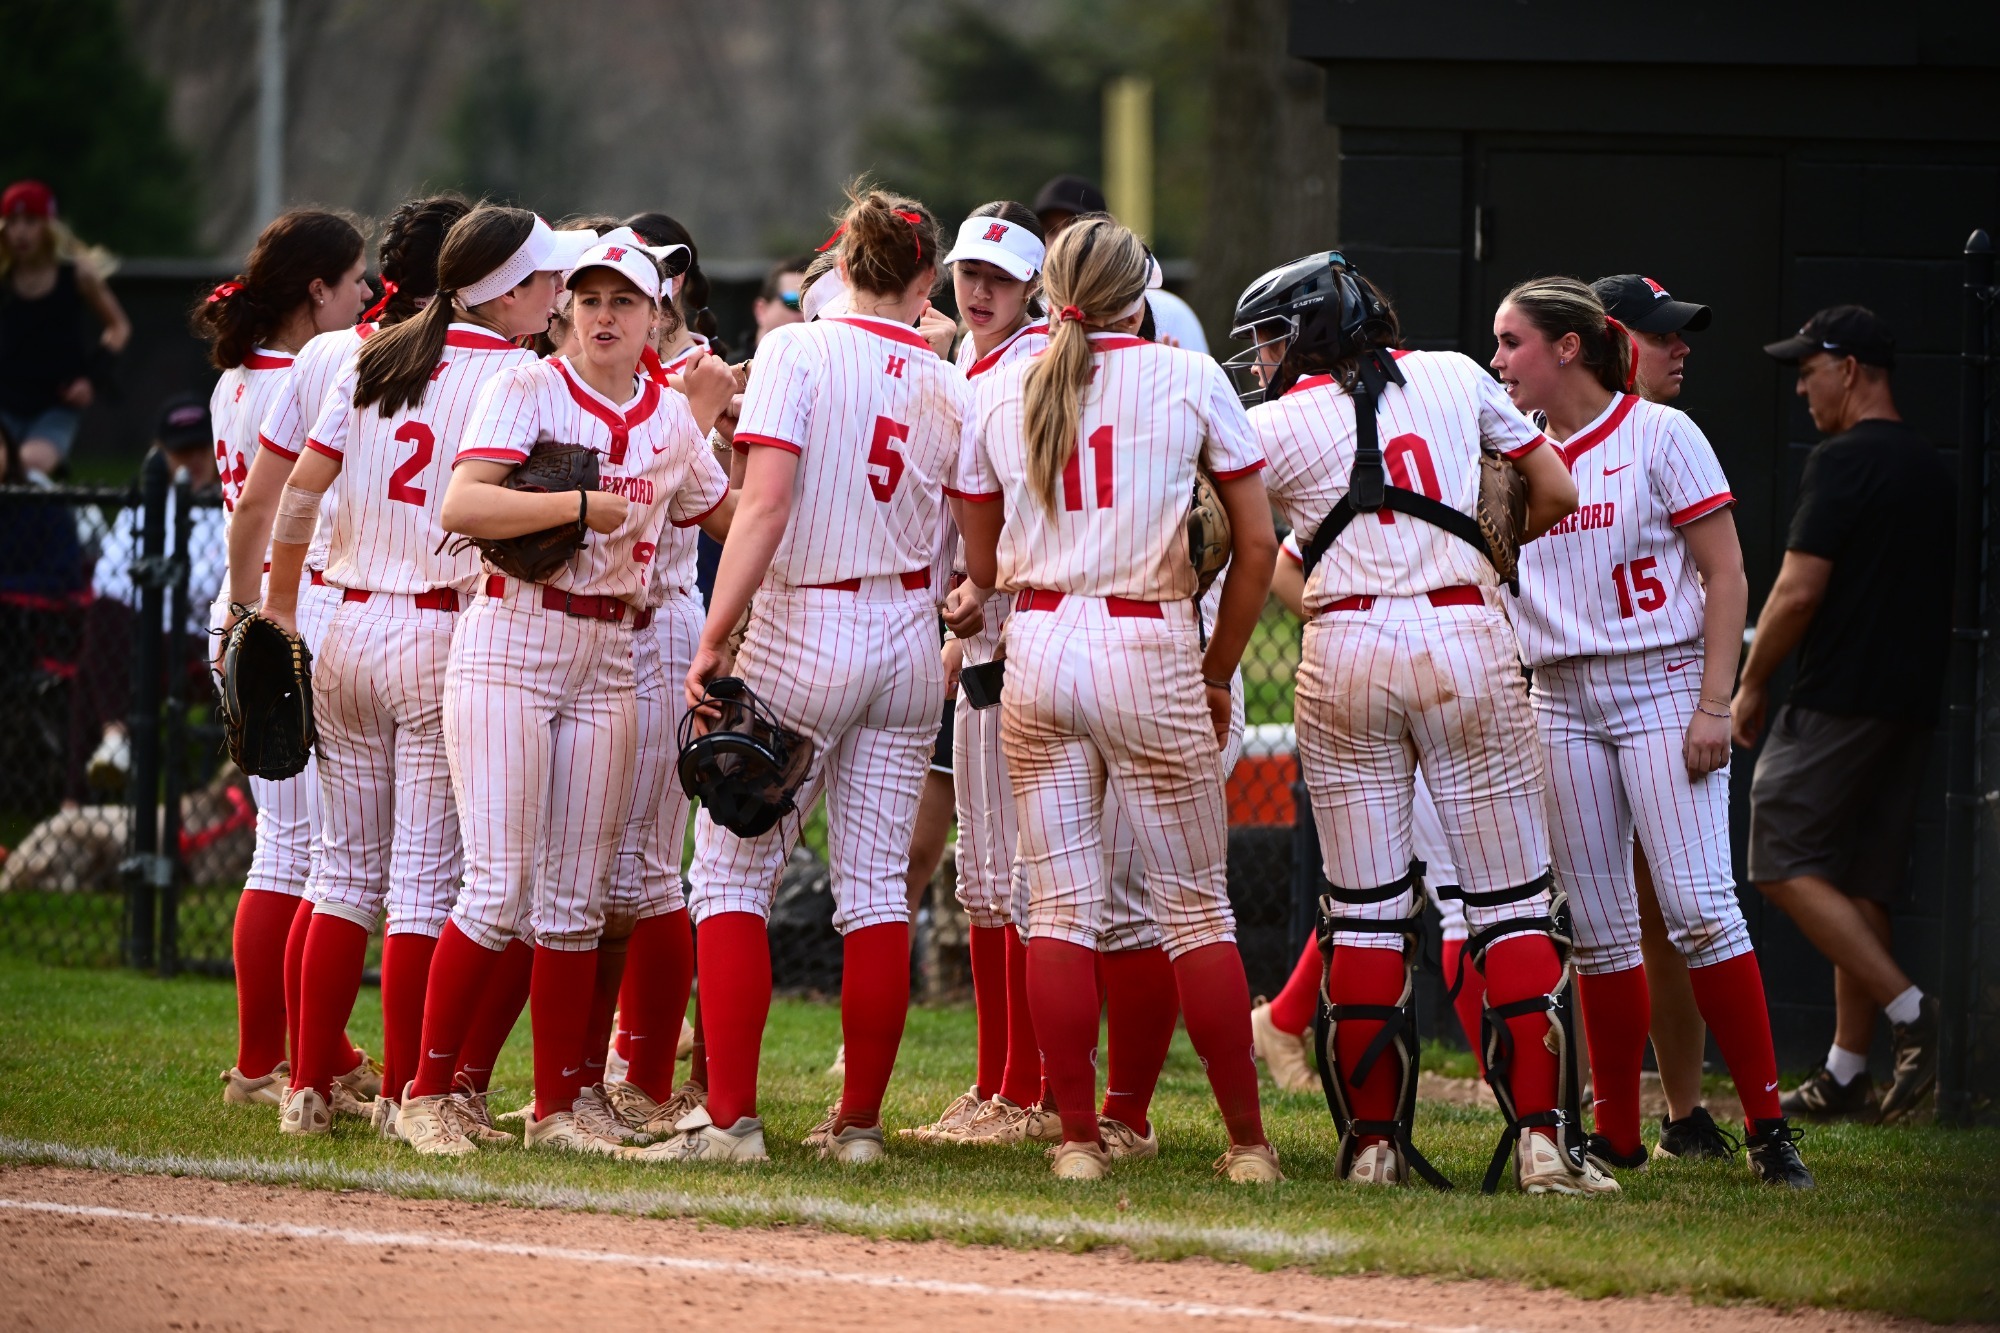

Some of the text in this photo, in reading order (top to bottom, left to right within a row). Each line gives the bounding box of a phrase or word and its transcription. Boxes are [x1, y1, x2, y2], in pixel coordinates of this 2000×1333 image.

[982, 222, 1010, 243] H
[602, 246, 628, 262] H
[1293, 296, 1324, 309] EASTON
[885, 354, 906, 379] H
[388, 420, 435, 508] 2
[867, 415, 910, 503] 5
[1062, 425, 1113, 512] 11
[599, 475, 654, 506] ERFORD
[1540, 502, 1615, 538] RFORD
[1611, 555, 1667, 620] 15
